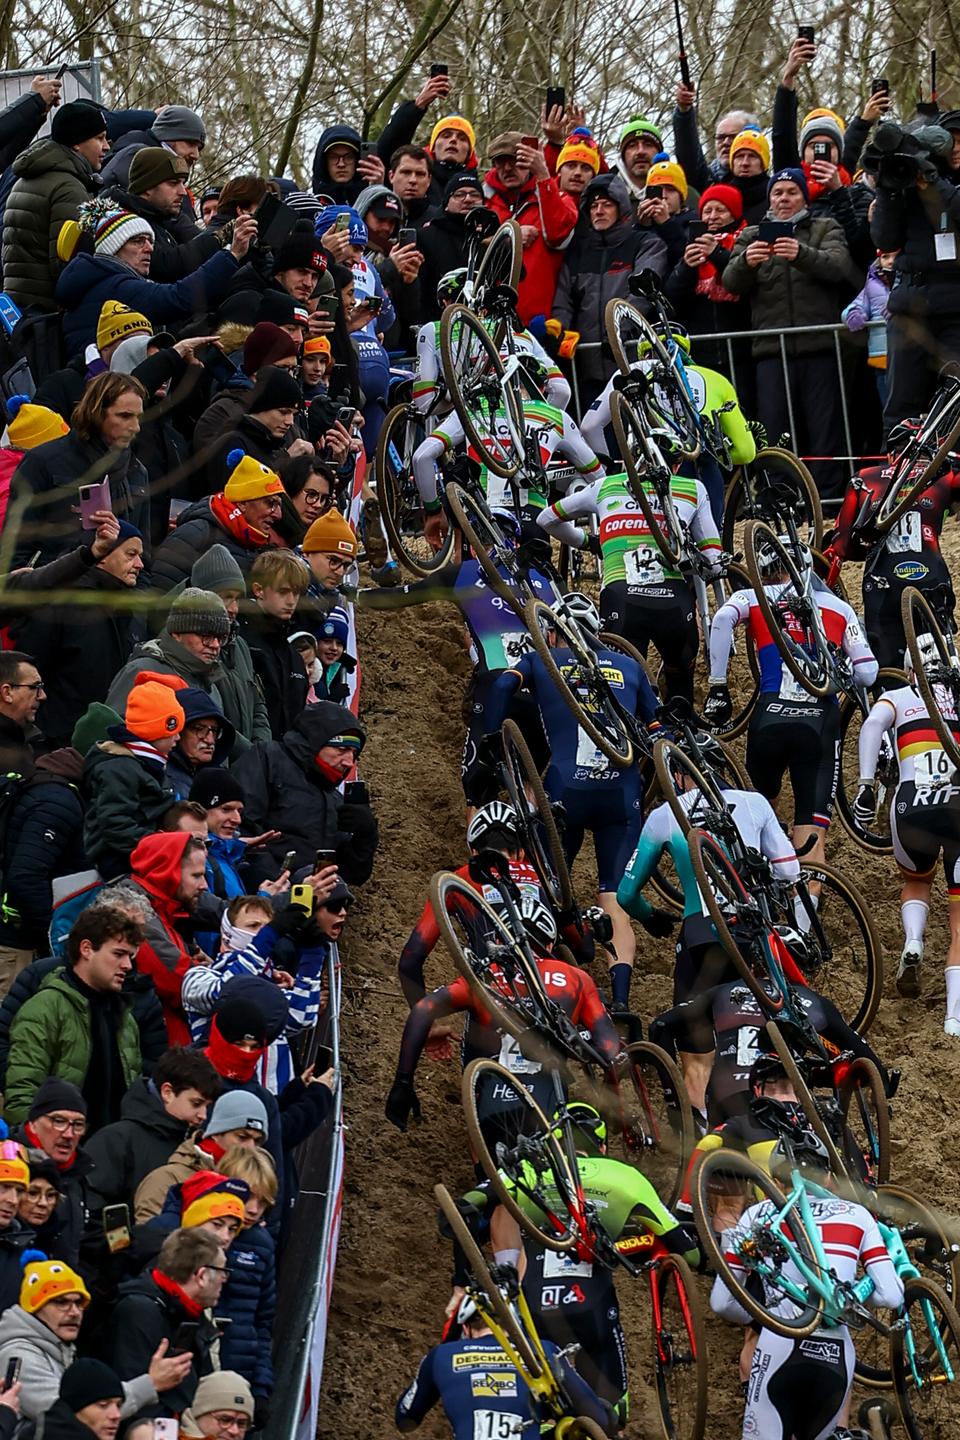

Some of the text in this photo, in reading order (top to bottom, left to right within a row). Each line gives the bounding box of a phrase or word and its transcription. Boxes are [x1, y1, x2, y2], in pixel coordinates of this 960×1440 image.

[848, 624, 859, 637] 10
[781, 706, 824, 717] FORCE
[924, 751, 948, 775] 16
[615, 1233, 655, 1251] RIDLEY
[485, 1410, 510, 1439] 15
